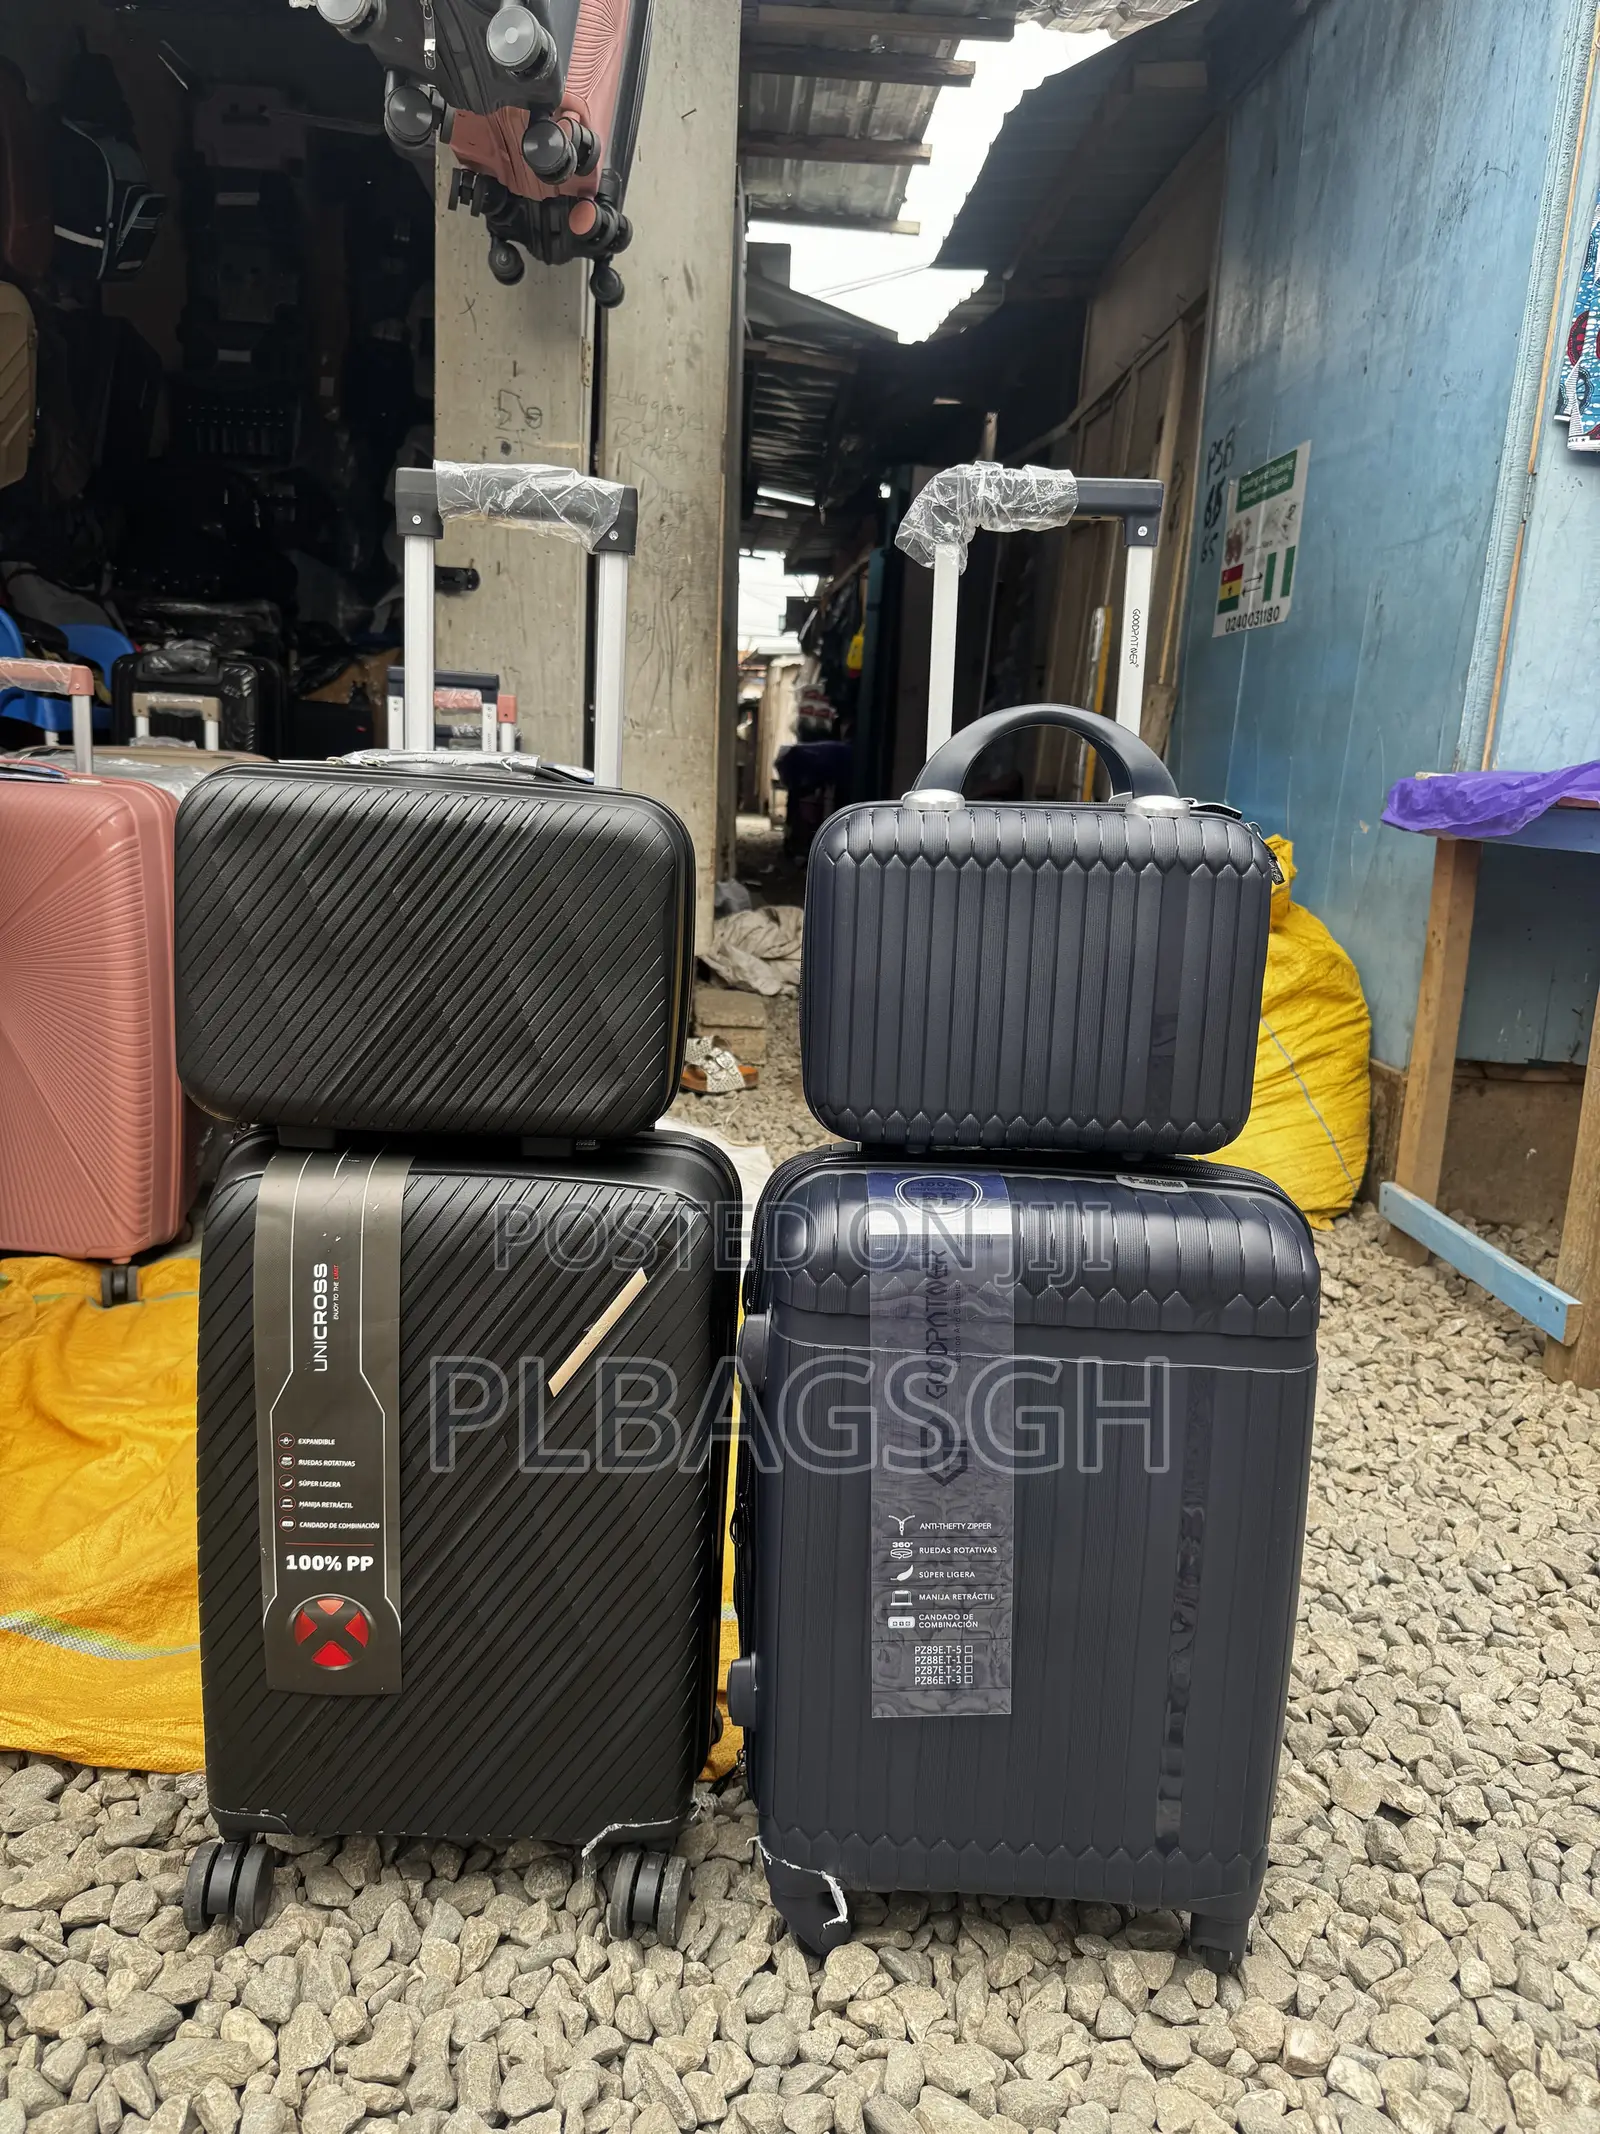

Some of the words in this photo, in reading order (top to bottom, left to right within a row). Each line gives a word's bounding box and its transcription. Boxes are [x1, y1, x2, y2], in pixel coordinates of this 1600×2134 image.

[1225, 605, 1280, 633] 0240031180
[333, 1293, 340, 1302] TO
[313, 1262, 328, 1372] UNICROSS
[298, 1438, 336, 1446] EXPANDIBLE
[298, 1459, 323, 1467] RUEDAS
[323, 1460, 356, 1468] ROTATIVAS
[298, 1501, 321, 1509] MANIJA
[299, 1521, 329, 1529] CANDADO
[919, 1522, 966, 1530] ANTI-THEFTY
[967, 1522, 992, 1530] ZIPPER
[919, 1546, 951, 1554] RUEDAS
[953, 1546, 998, 1554] ROTATIVAS
[286, 1554, 343, 1572] 100%
[346, 1555, 374, 1572] PP
[952, 1592, 995, 1600] RETRÁCTIL
[918, 1613, 961, 1621] CANDADO
[918, 1620, 979, 1628] COMBINACIÓN
[914, 1645, 962, 1655] PZ89E.T-5
[914, 1655, 962, 1665] PZ88E.T-1
[914, 1665, 962, 1675] PZ87E.T-2
[914, 1675, 962, 1685] PZ86E.T-3
